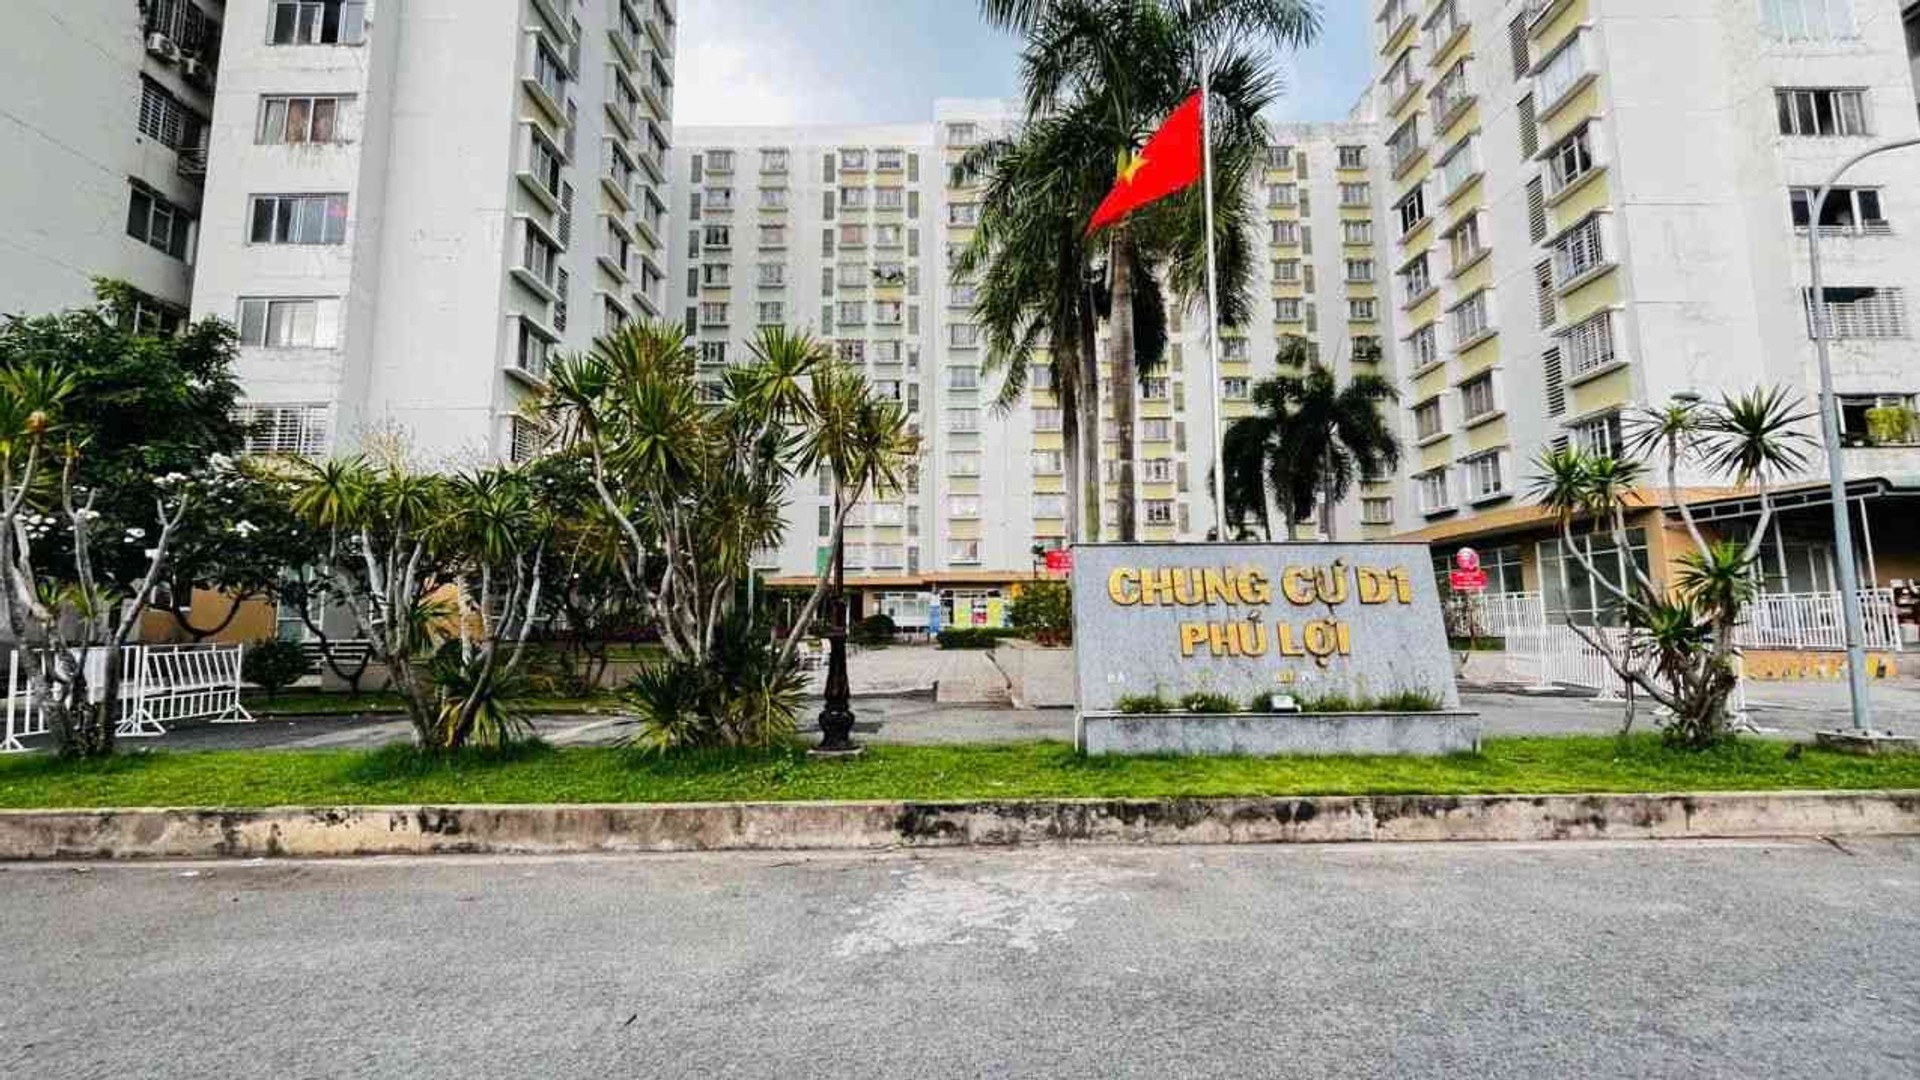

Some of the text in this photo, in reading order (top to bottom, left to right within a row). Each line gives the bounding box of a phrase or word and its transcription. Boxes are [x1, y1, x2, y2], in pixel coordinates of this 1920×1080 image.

[1107, 565, 1271, 606] CHUNG
[1356, 564, 1413, 606] D1
[1180, 609, 1351, 668] PHÚ LỢI
